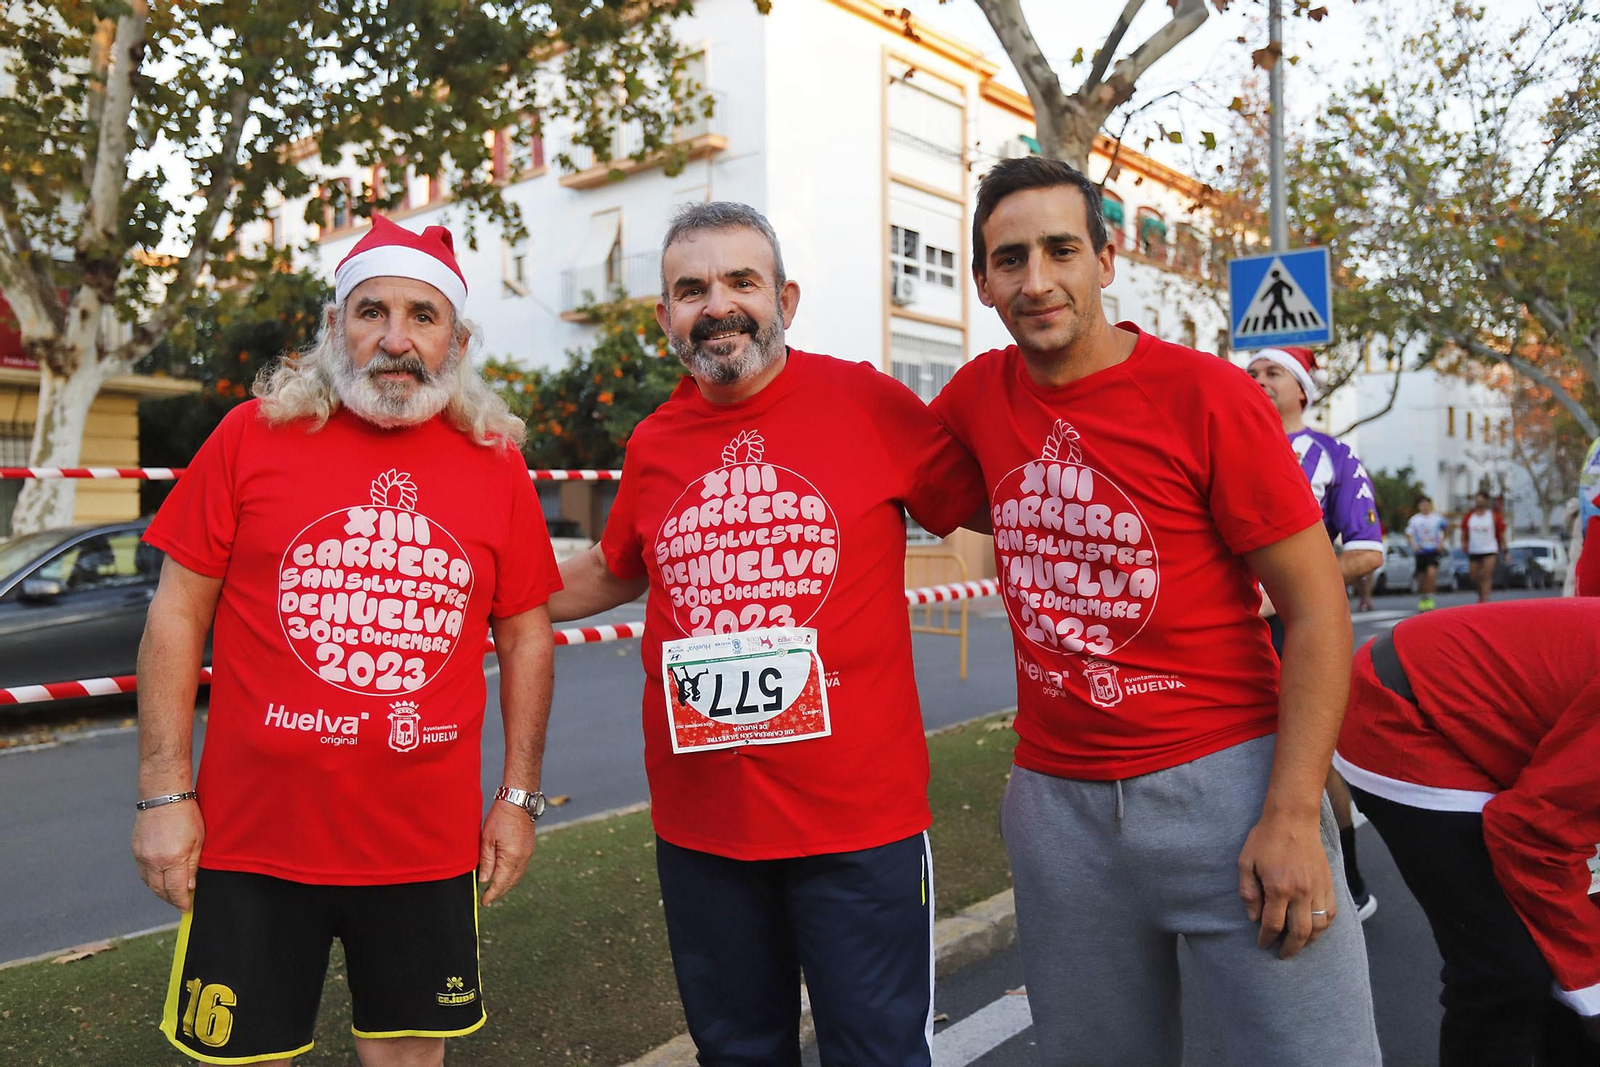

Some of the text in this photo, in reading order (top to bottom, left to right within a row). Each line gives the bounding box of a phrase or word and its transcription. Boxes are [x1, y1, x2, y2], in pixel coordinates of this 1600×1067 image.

[700, 465, 777, 499] XIII
[1020, 462, 1094, 501] XIII
[343, 507, 430, 545] XIII
[663, 491, 826, 538] CARRERA
[994, 496, 1141, 545] CARRERA
[704, 524, 836, 551] SILVESTRE
[1025, 533, 1153, 566] SILVESTRE
[293, 537, 470, 587] CARRERA
[688, 547, 836, 587] HUELVA
[1010, 555, 1156, 598] HUELVA
[280, 568, 467, 609] SAN SILVESTRE
[724, 579, 822, 601] DICIEMBRE
[1043, 591, 1141, 619] DICIEMBRE
[281, 591, 463, 637] DE HUELVA
[690, 604, 796, 638] 2023
[288, 616, 451, 654] 30 DE DICIEMBRE
[316, 642, 426, 690] 2023
[709, 667, 783, 717] 577
[1125, 680, 1186, 696] HUELVA
[265, 703, 359, 735] Huelva
[423, 731, 458, 743] HUELVA
[320, 735, 358, 746] original
[706, 734, 740, 743] SILVESTRE
[182, 977, 237, 1048] 16
